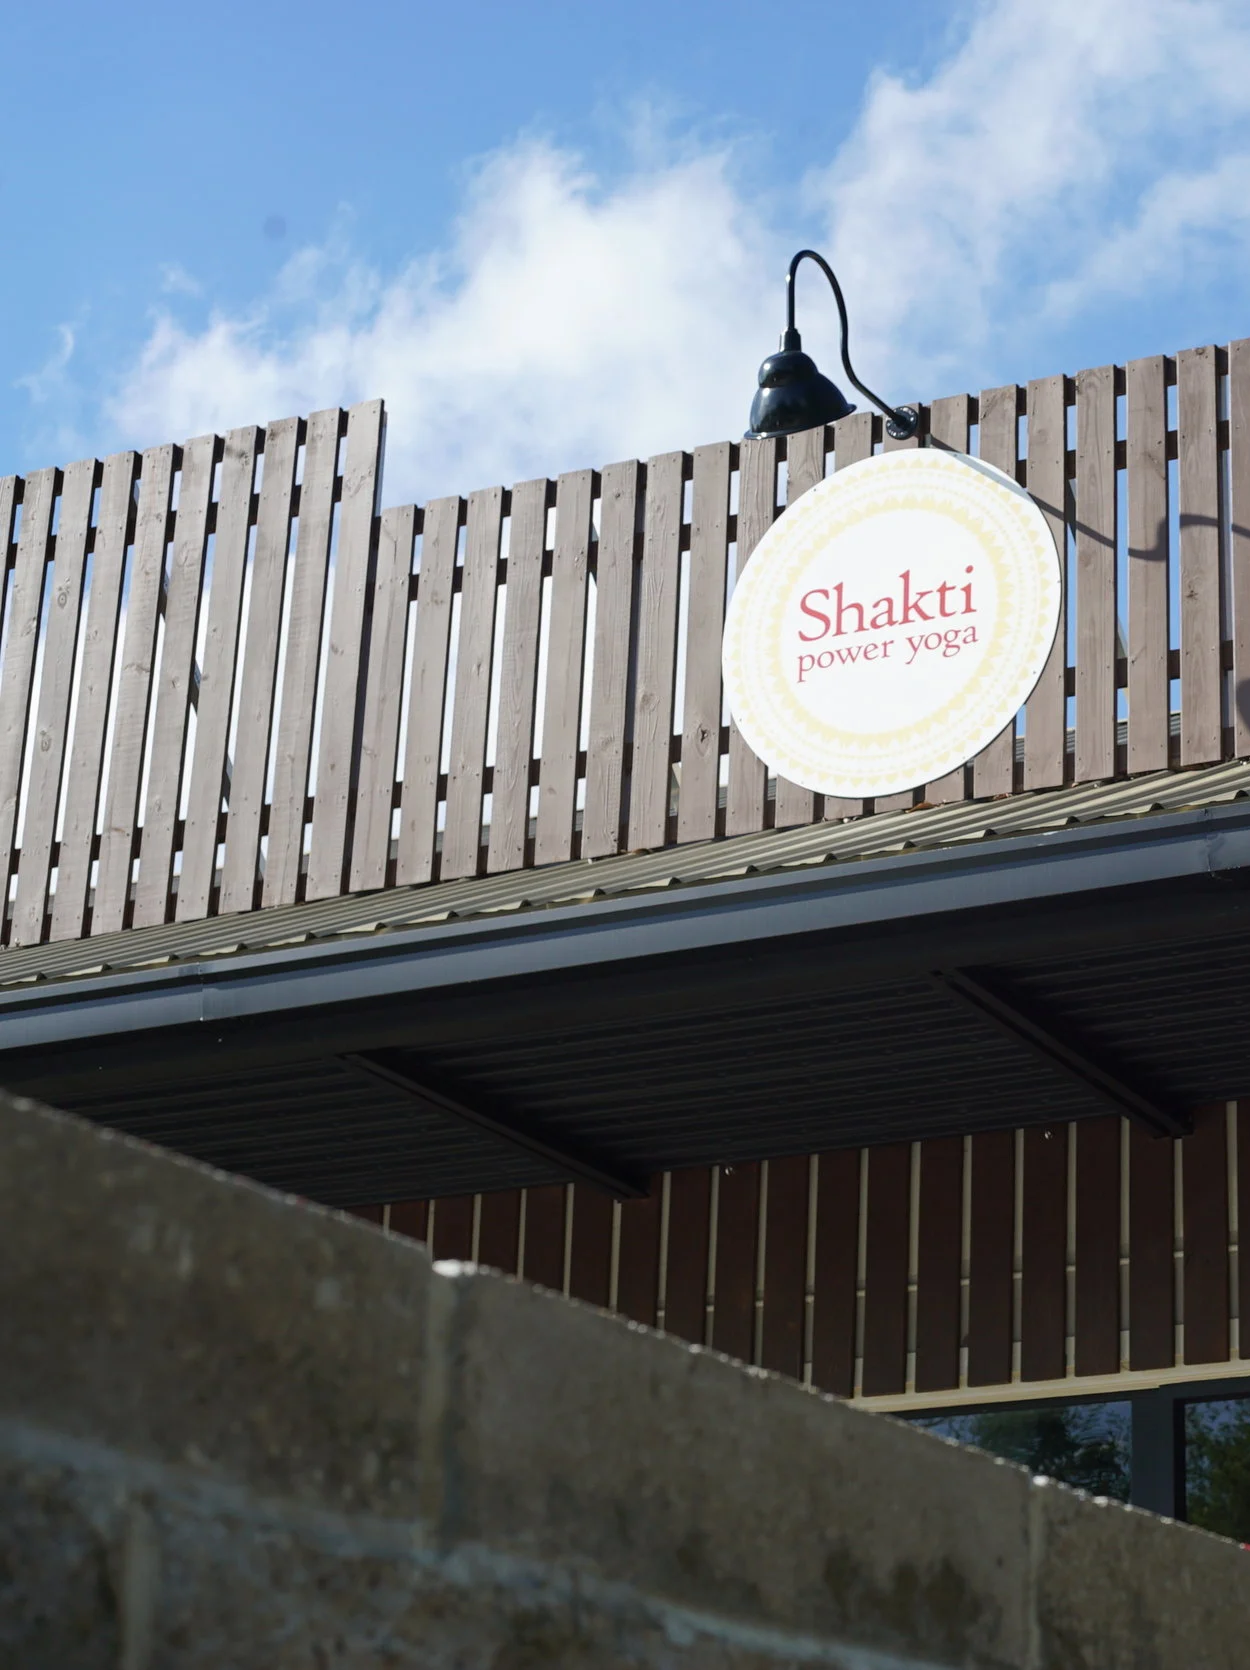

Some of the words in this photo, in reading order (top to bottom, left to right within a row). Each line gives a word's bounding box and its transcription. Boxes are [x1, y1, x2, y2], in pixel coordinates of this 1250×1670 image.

[798, 565, 977, 642] Shakti
[797, 640, 895, 683] power
[905, 626, 979, 665] yoga
